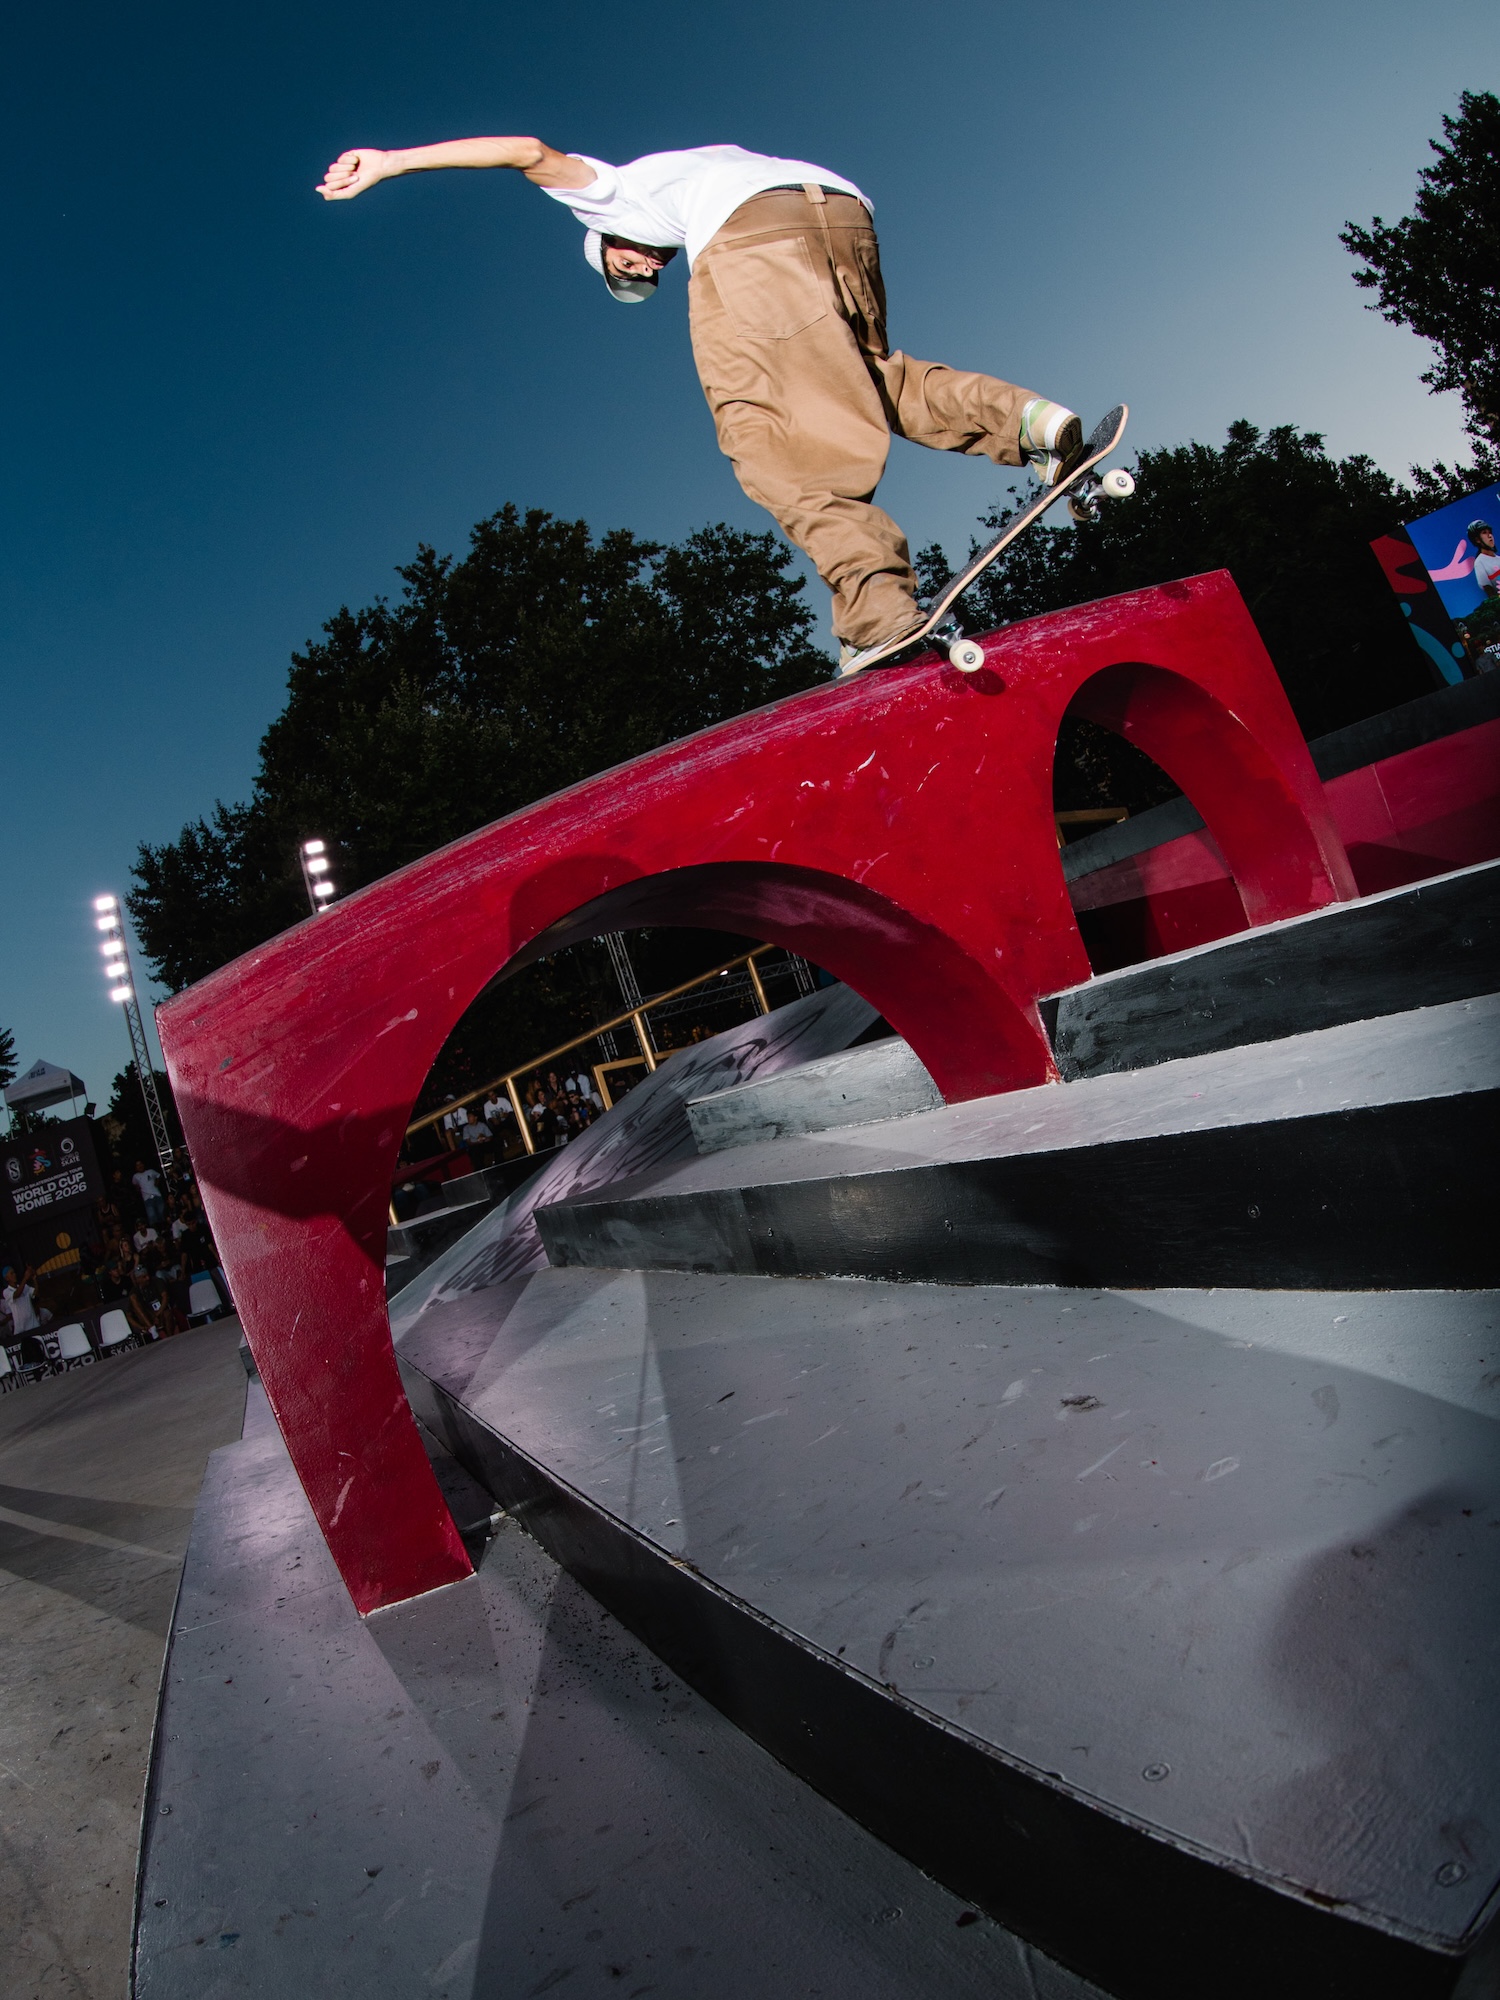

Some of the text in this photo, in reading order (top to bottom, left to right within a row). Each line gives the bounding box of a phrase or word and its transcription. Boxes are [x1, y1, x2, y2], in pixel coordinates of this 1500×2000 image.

[61, 1156, 80, 1167] SKATE
[12, 1184, 28, 1194] WORLD
[29, 1172, 68, 1188] SKATEBOARDING
[13, 1172, 84, 1204] WORLD CUP
[16, 1182, 87, 1214] ROME 2026
